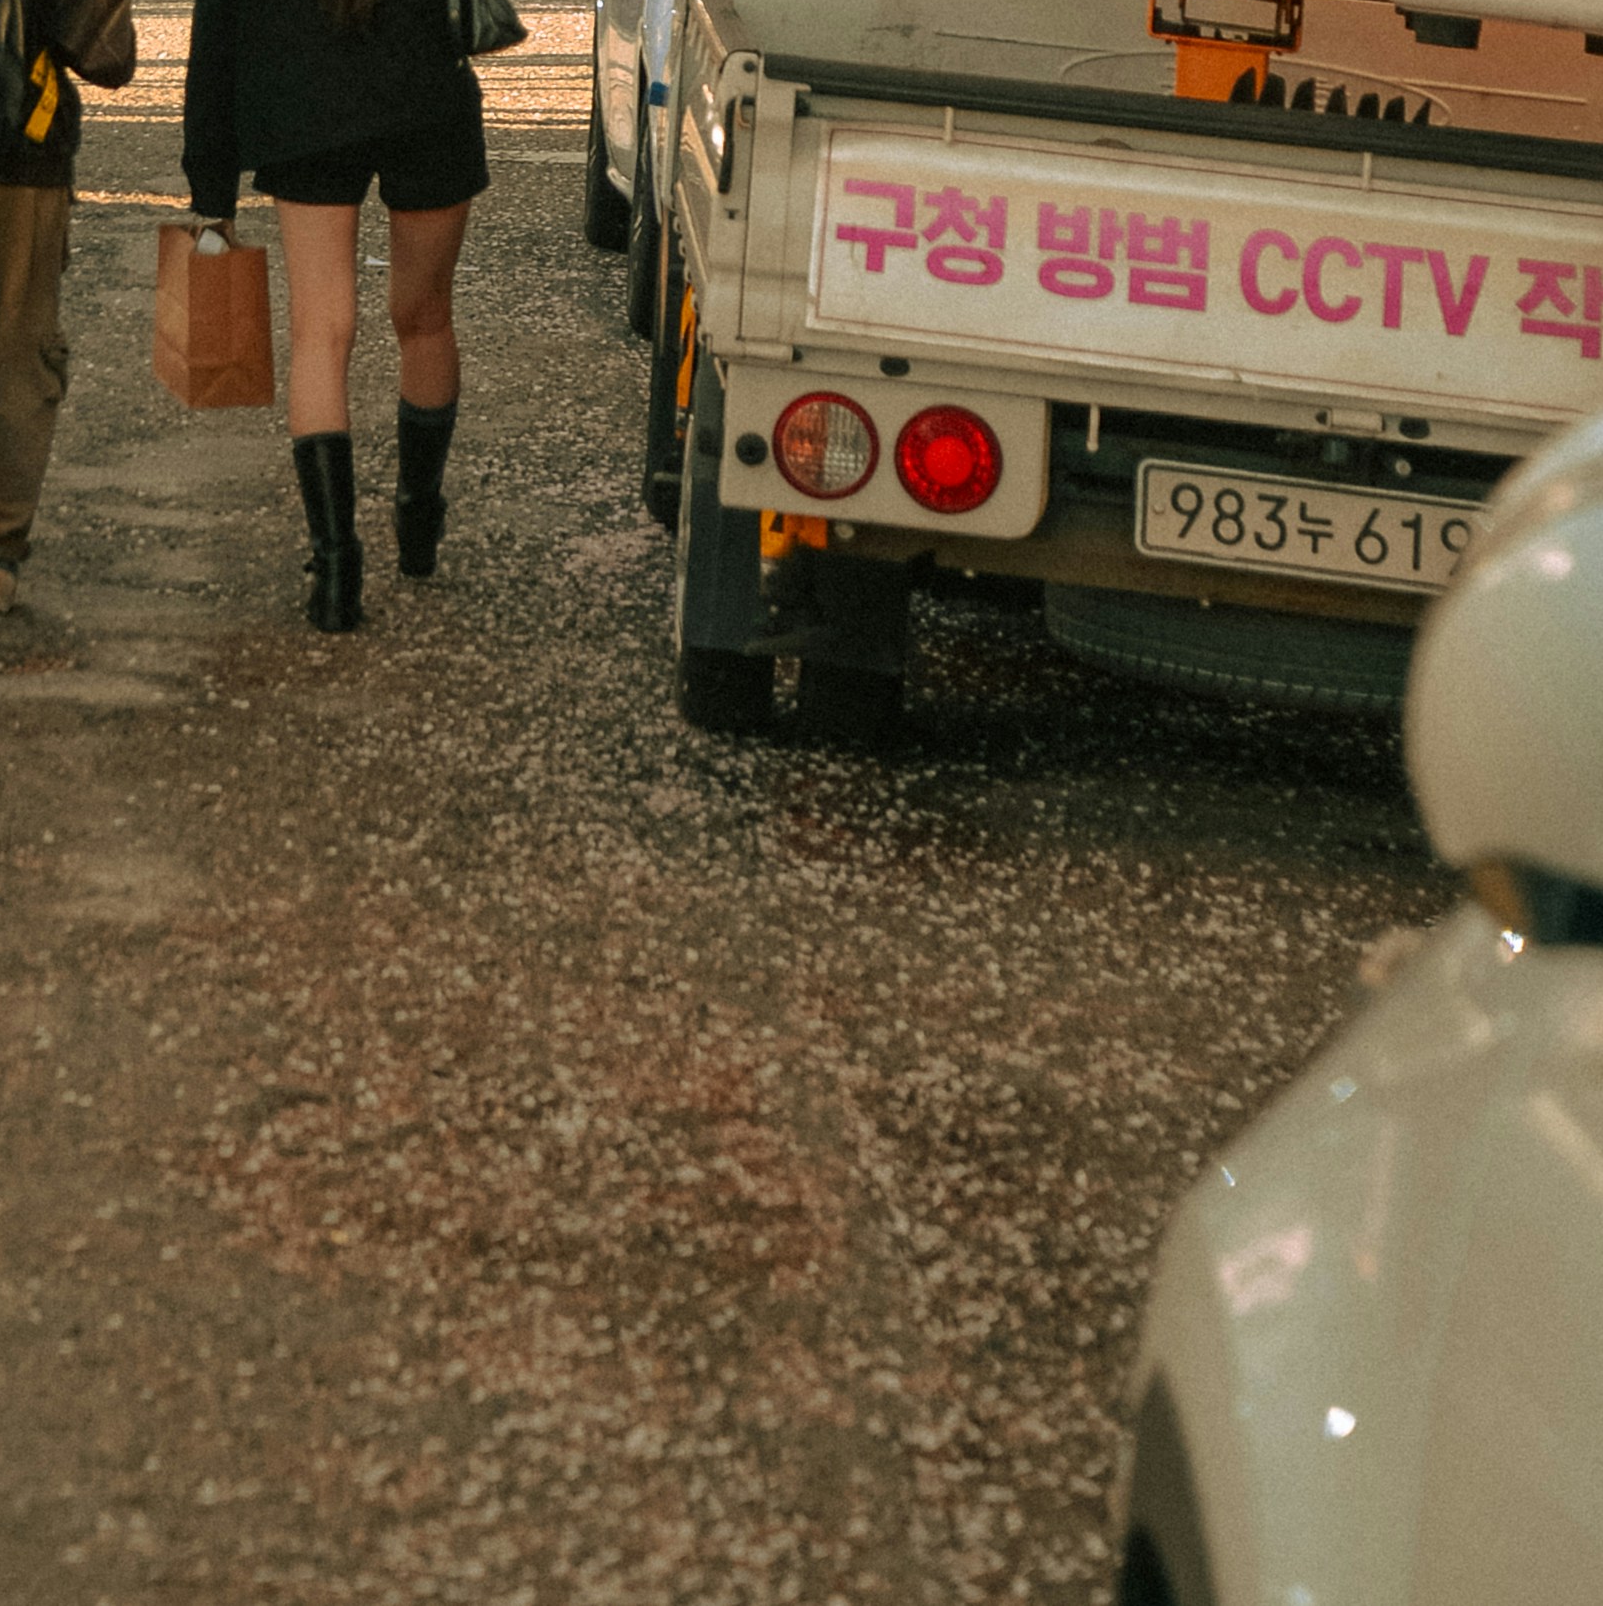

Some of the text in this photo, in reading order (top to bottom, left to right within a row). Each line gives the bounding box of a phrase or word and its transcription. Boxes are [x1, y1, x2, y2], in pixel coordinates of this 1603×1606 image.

[836, 177, 1008, 287] 구청
[1037, 201, 1211, 313] 방범
[1239, 229, 1490, 338] CCTV
[1170, 482, 1334, 554] 983누
